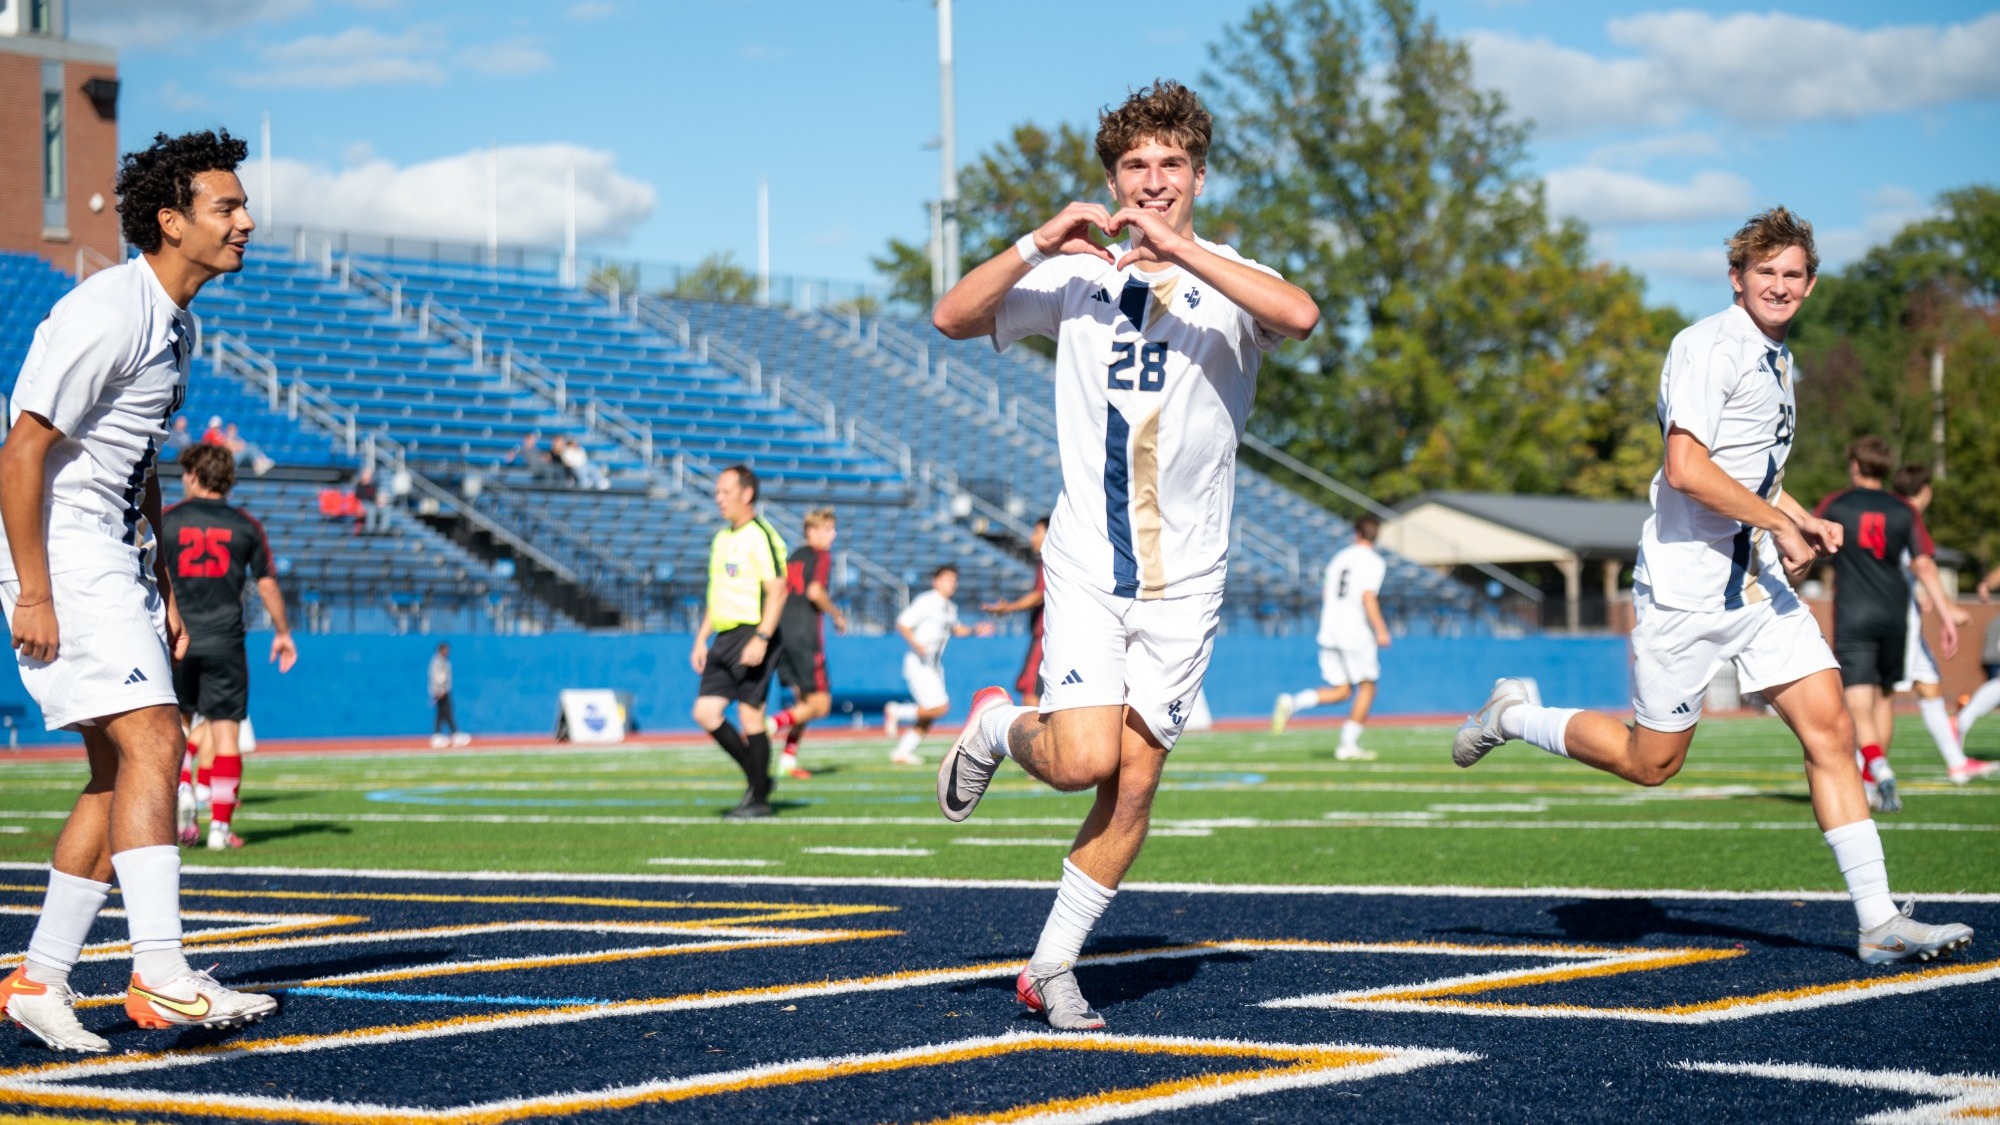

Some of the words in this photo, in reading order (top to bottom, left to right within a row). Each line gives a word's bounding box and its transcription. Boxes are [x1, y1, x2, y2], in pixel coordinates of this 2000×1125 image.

[1107, 341, 1168, 392] 28
[178, 527, 233, 578] 25
[1858, 511, 1887, 560] 4
